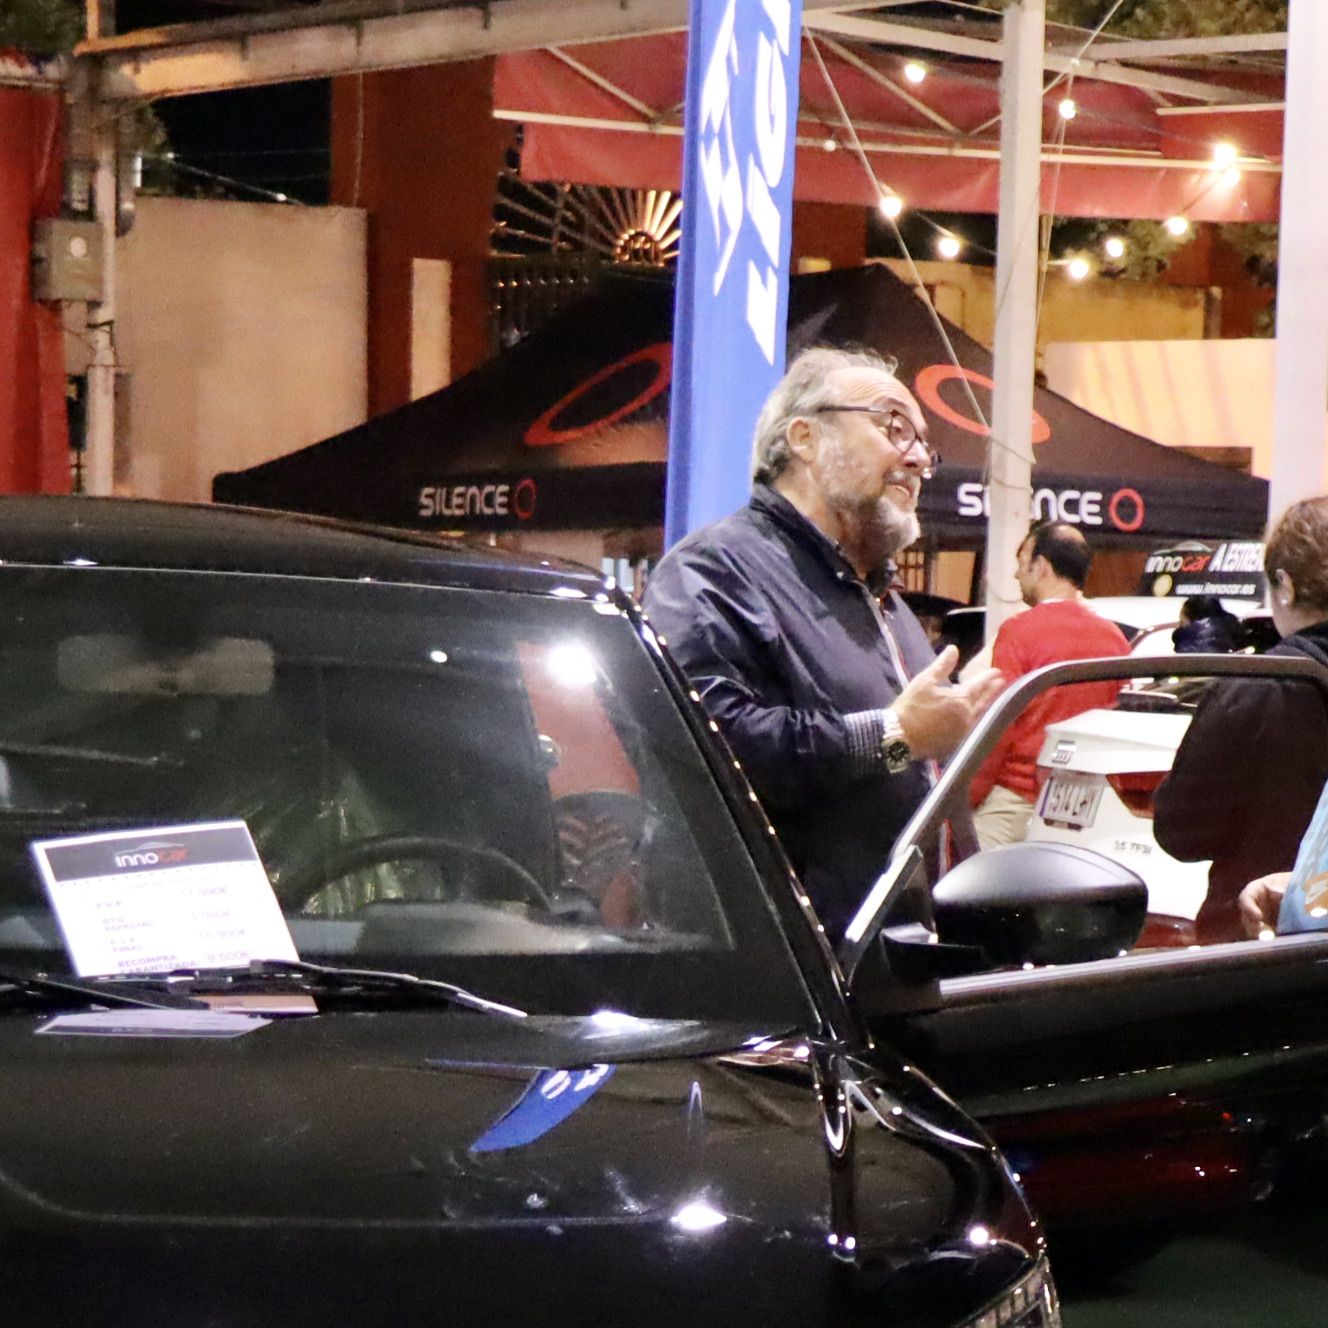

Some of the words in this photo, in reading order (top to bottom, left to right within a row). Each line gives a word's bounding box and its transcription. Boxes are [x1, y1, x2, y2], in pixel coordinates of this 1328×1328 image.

[419, 485, 510, 516] SILENCE
[957, 483, 1103, 525] SINCE
[1145, 556, 1212, 573] innocar
[1175, 582, 1256, 595] www.innocar.es
[114, 846, 189, 868] innocar
